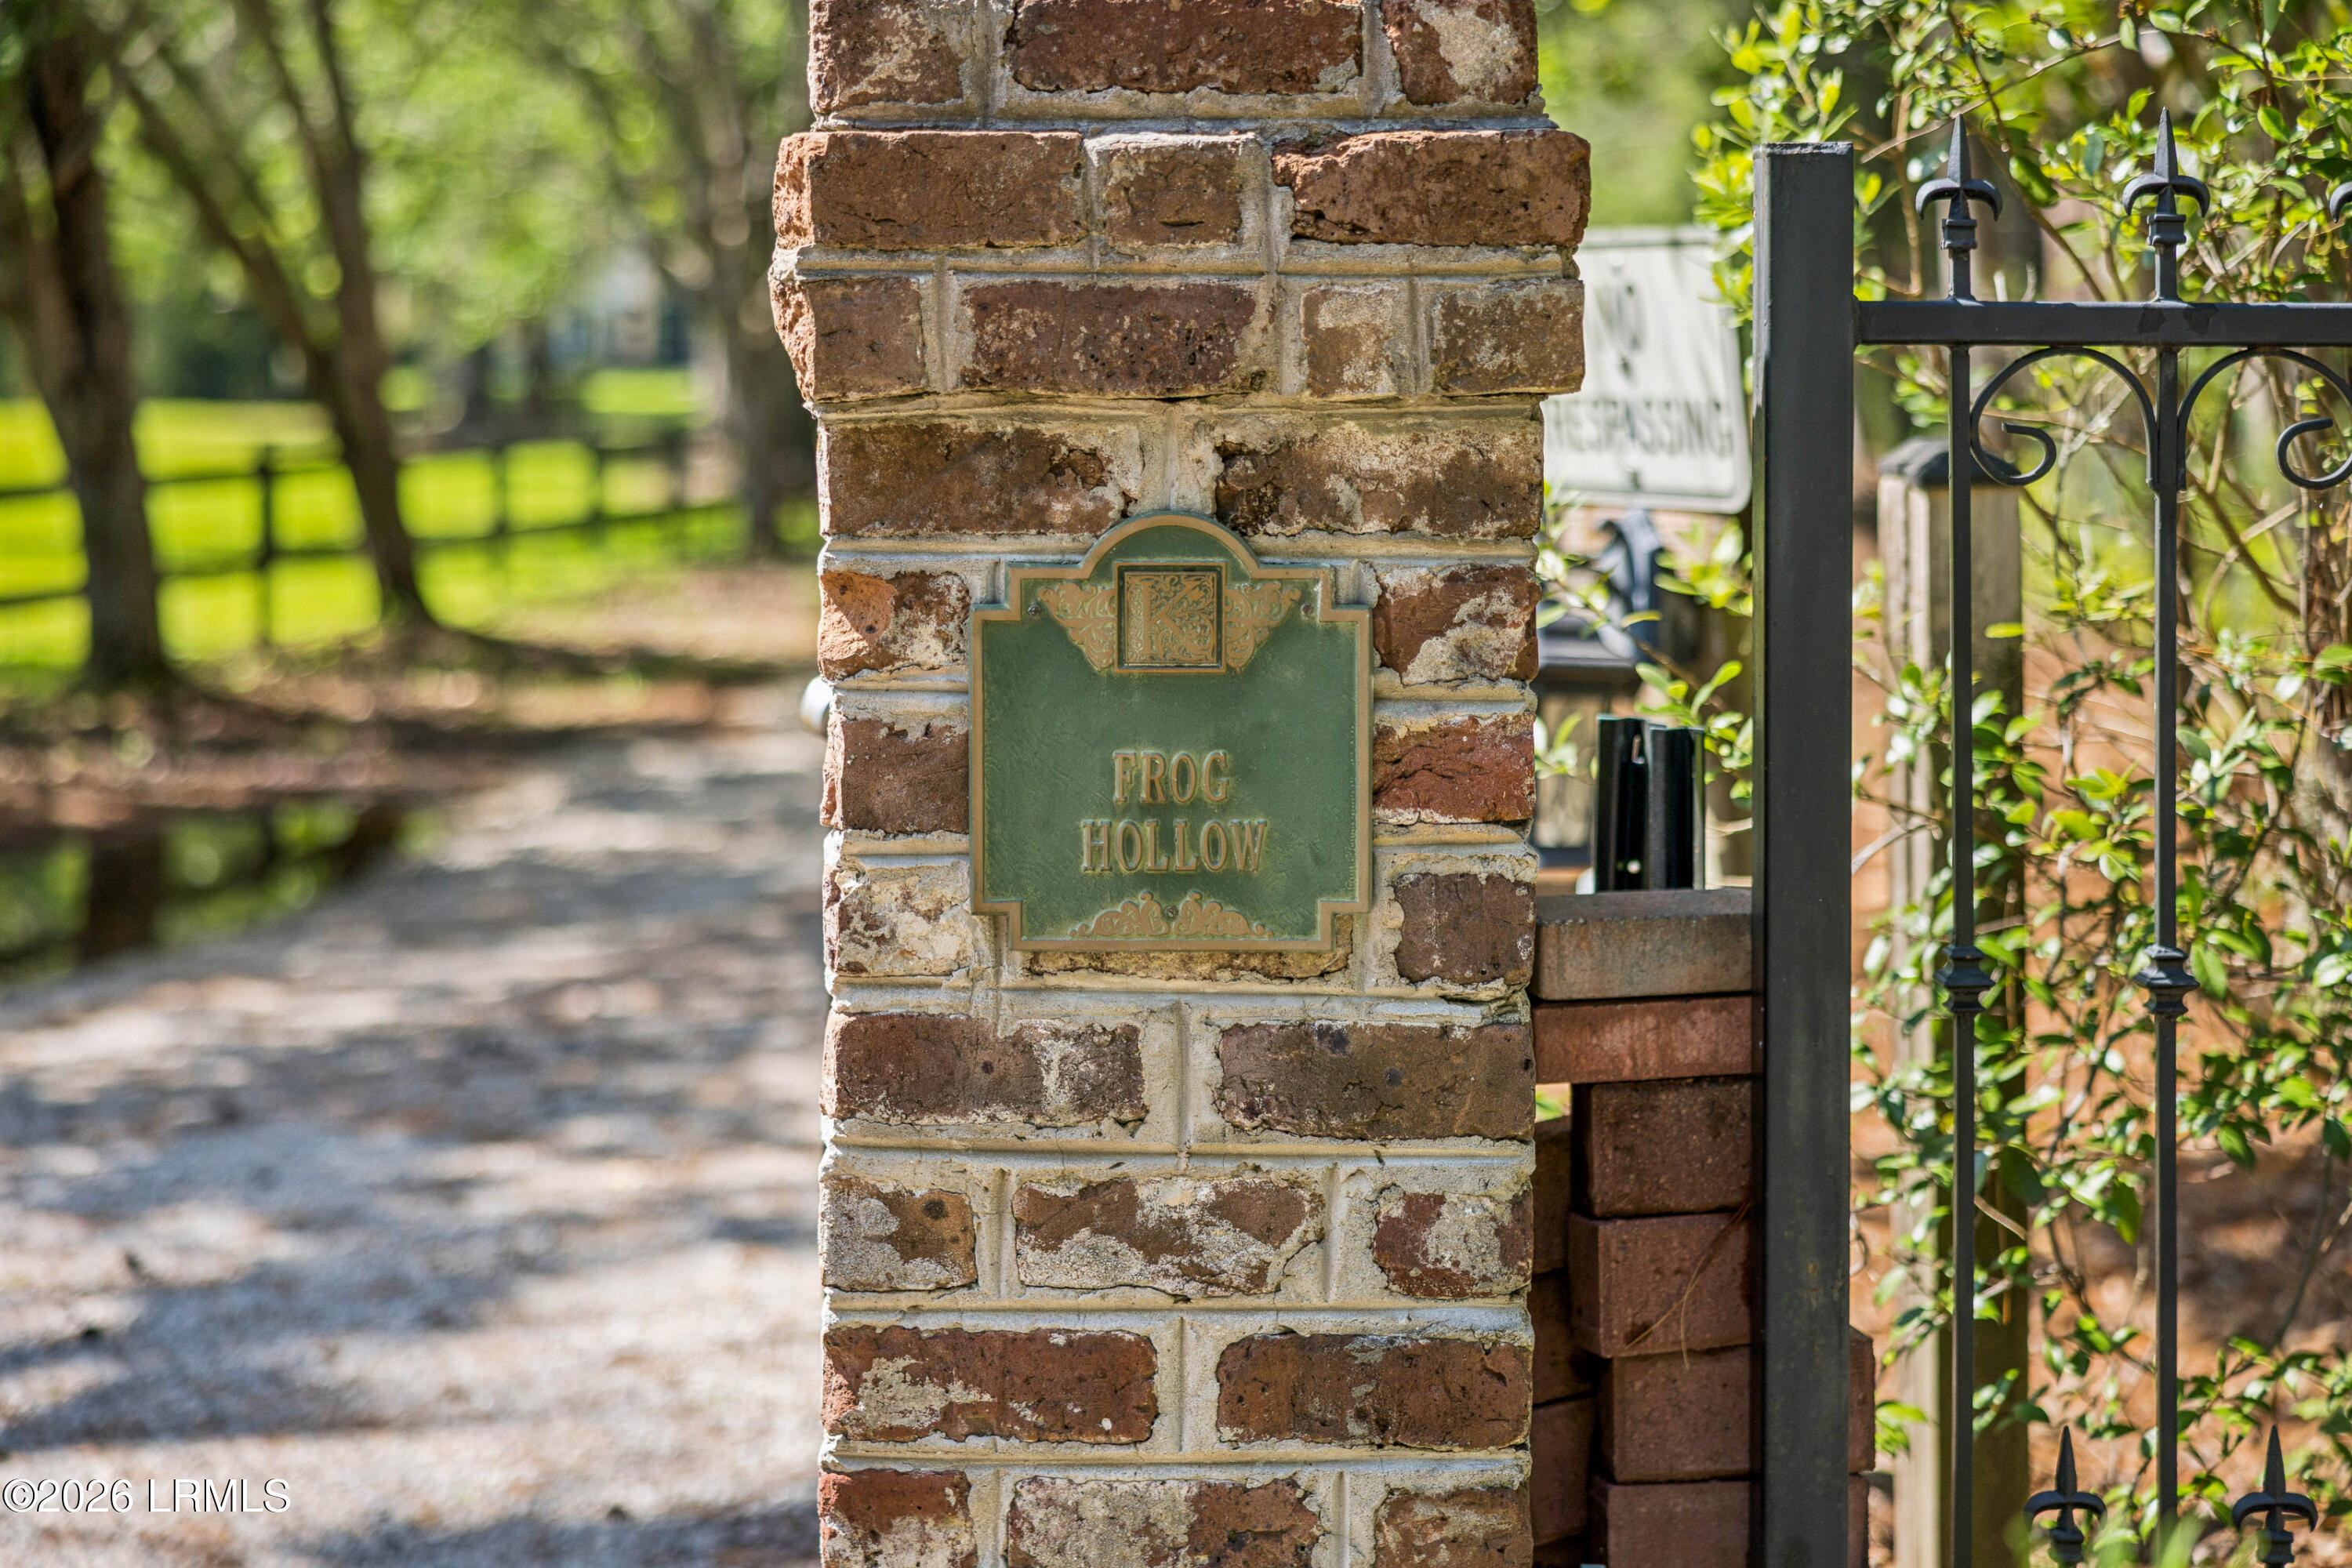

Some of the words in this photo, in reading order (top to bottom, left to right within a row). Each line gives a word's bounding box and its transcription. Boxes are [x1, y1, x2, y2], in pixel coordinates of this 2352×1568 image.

[1546, 398, 1733, 458] RESPASSING
[1112, 750, 1230, 804] FROG
[1081, 819, 1268, 872] HOLLOW
